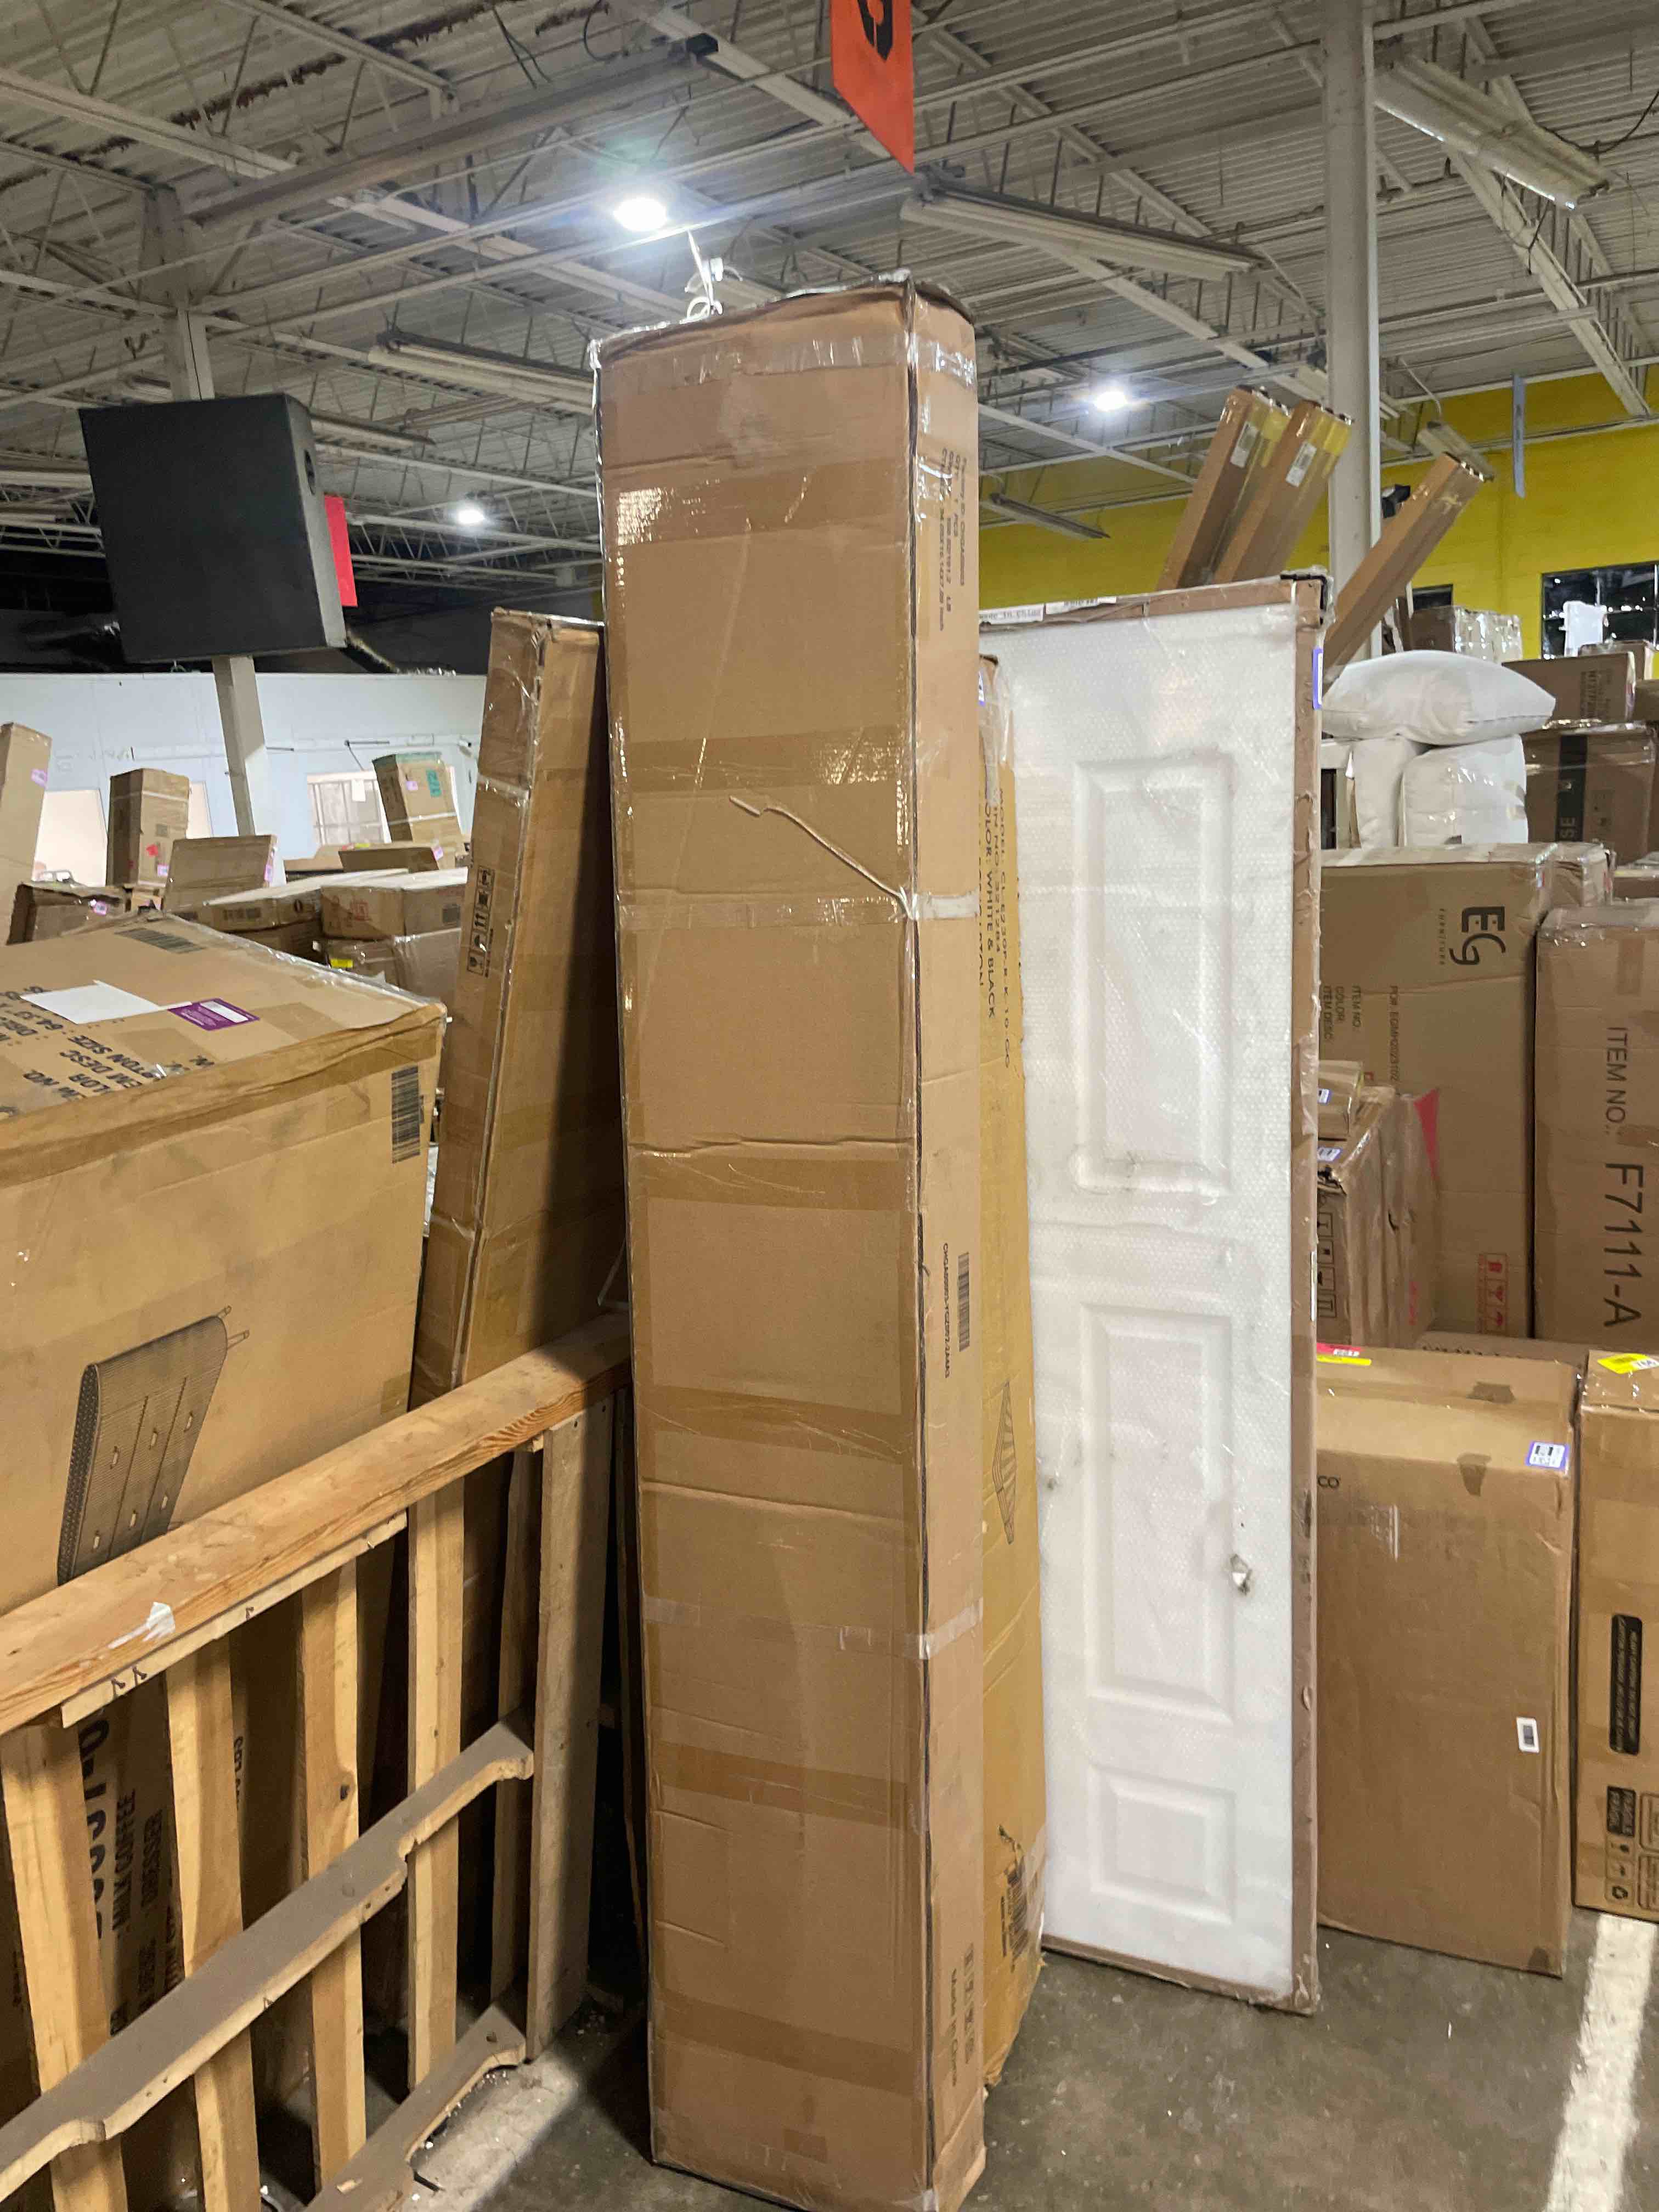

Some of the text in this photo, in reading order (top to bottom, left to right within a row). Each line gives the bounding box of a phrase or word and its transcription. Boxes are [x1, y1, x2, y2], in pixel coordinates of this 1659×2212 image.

[987, 938, 994, 951] &
[1606, 1027, 1628, 1082] ITEM
[1602, 1163, 1644, 1328] F7111-A
